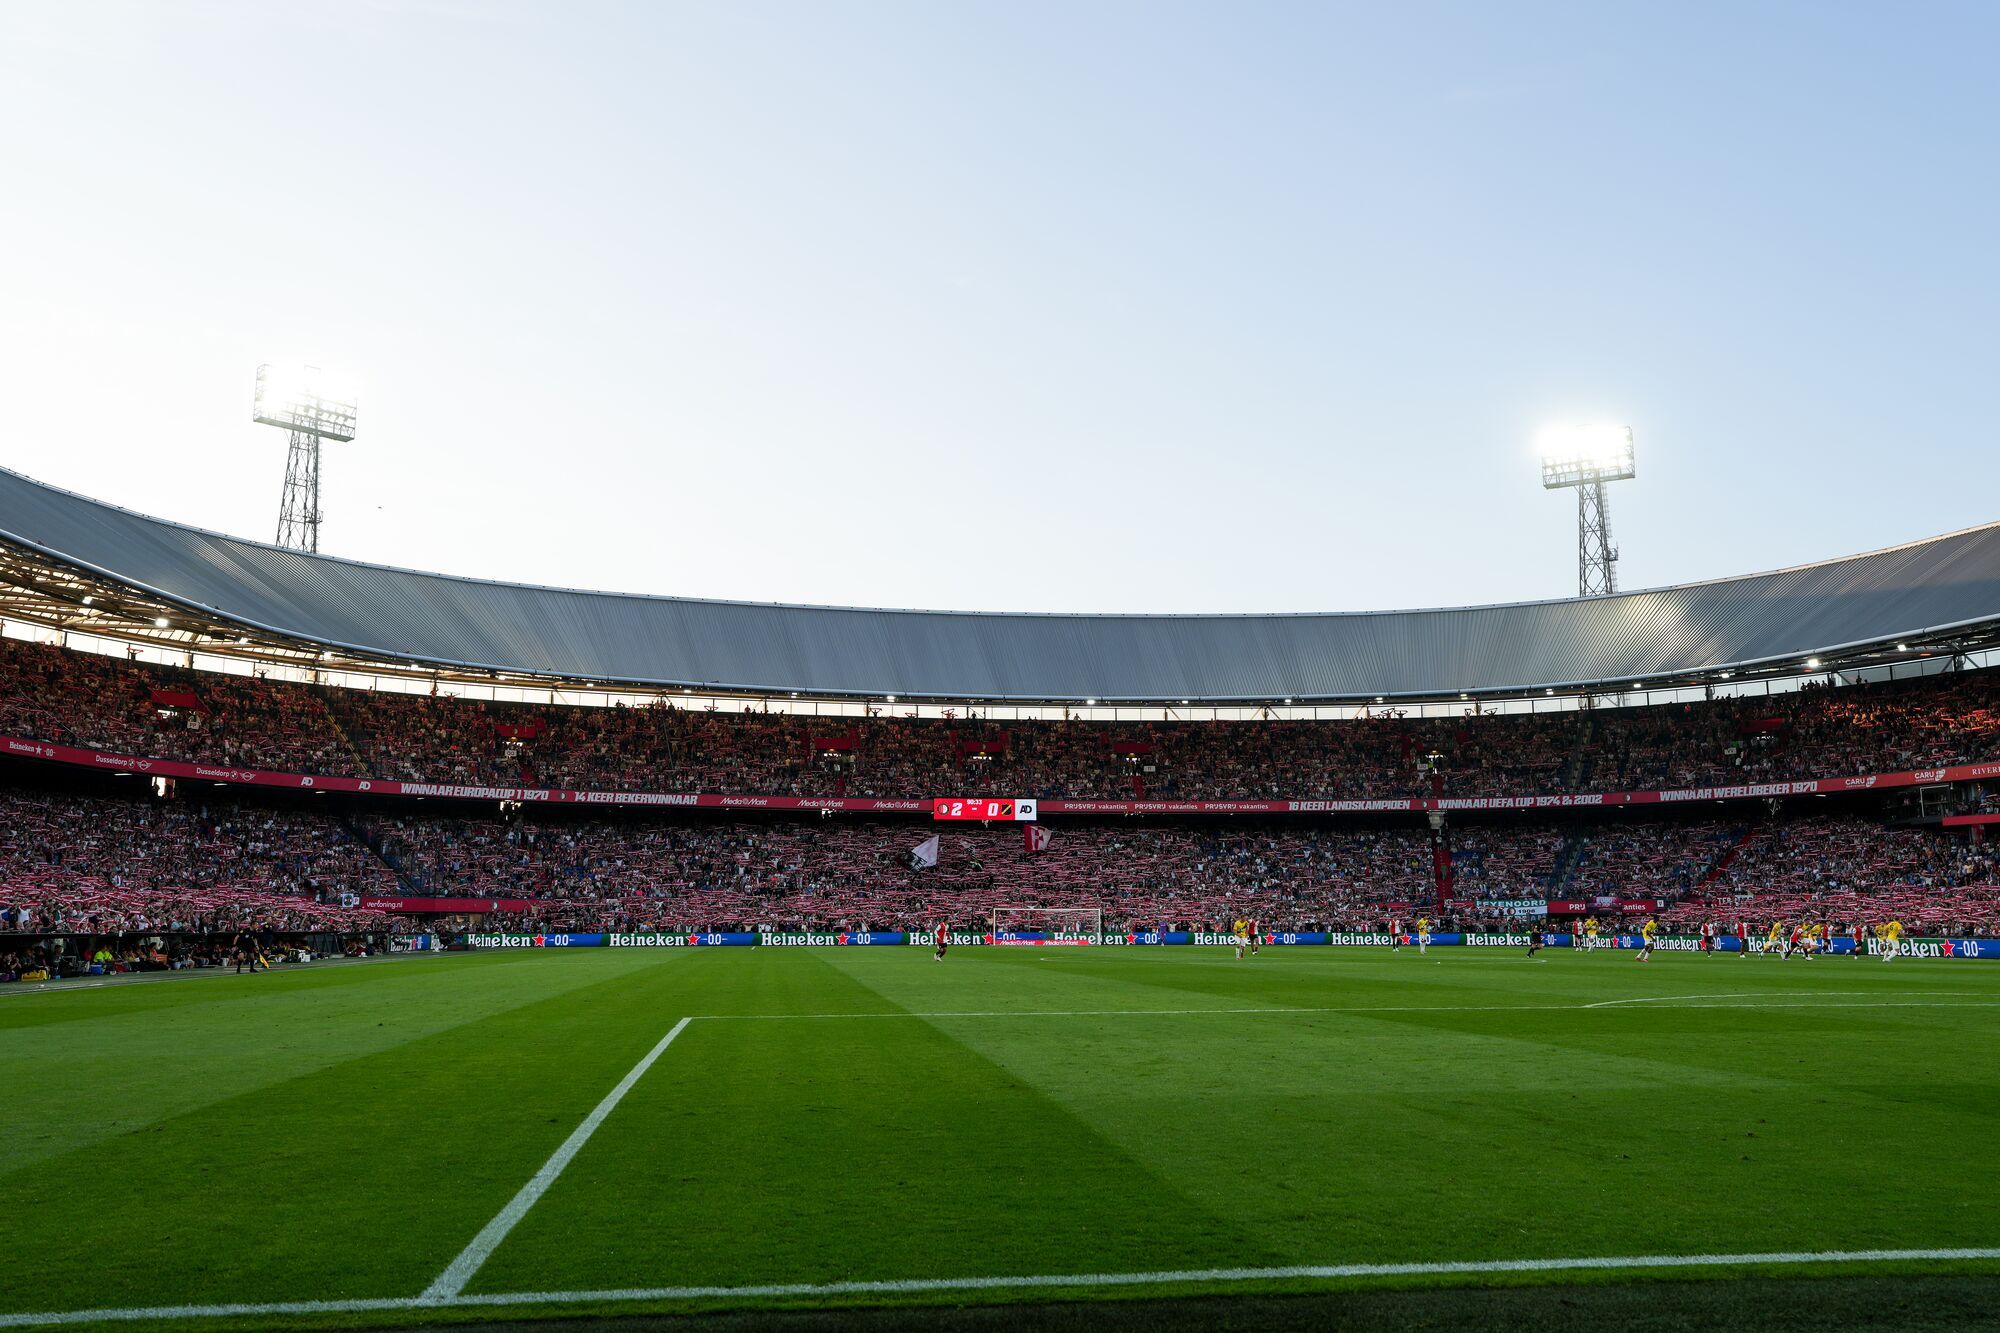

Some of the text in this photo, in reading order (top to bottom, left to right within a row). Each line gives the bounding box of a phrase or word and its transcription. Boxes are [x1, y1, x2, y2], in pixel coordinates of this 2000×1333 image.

[9, 741, 35, 752] Heineken
[95, 755, 128, 766] Dusseldorp
[196, 768, 230, 778] Dusseldorp
[1914, 771, 1934, 779] CARU
[1972, 766, 2000, 775] RIVER
[301, 777, 314, 786] AD
[359, 782, 371, 790] AD
[401, 783, 454, 795] WINNAAR
[453, 786, 515, 798] EUROPACUP
[523, 790, 549, 800] 1970
[1660, 781, 1818, 801] WINNAAR WERELDBEKER 1970
[574, 791, 698, 805] 14 KEER BEKERWINNAAR
[1437, 799, 1489, 809] WINNAAR
[1489, 798, 1514, 808] UEFA
[1515, 798, 1534, 807] CUP
[1536, 796, 1561, 806] 1974
[1573, 794, 1603, 804] 2002
[951, 803, 962, 816] 2
[988, 803, 999, 816] 0
[1020, 805, 1032, 814] AD
[1288, 800, 1410, 810] 16 KEER LANDSKAMPIOEN
[468, 934, 530, 948] Heineken
[609, 934, 684, 946] Heineken
[761, 933, 834, 946] Heineken
